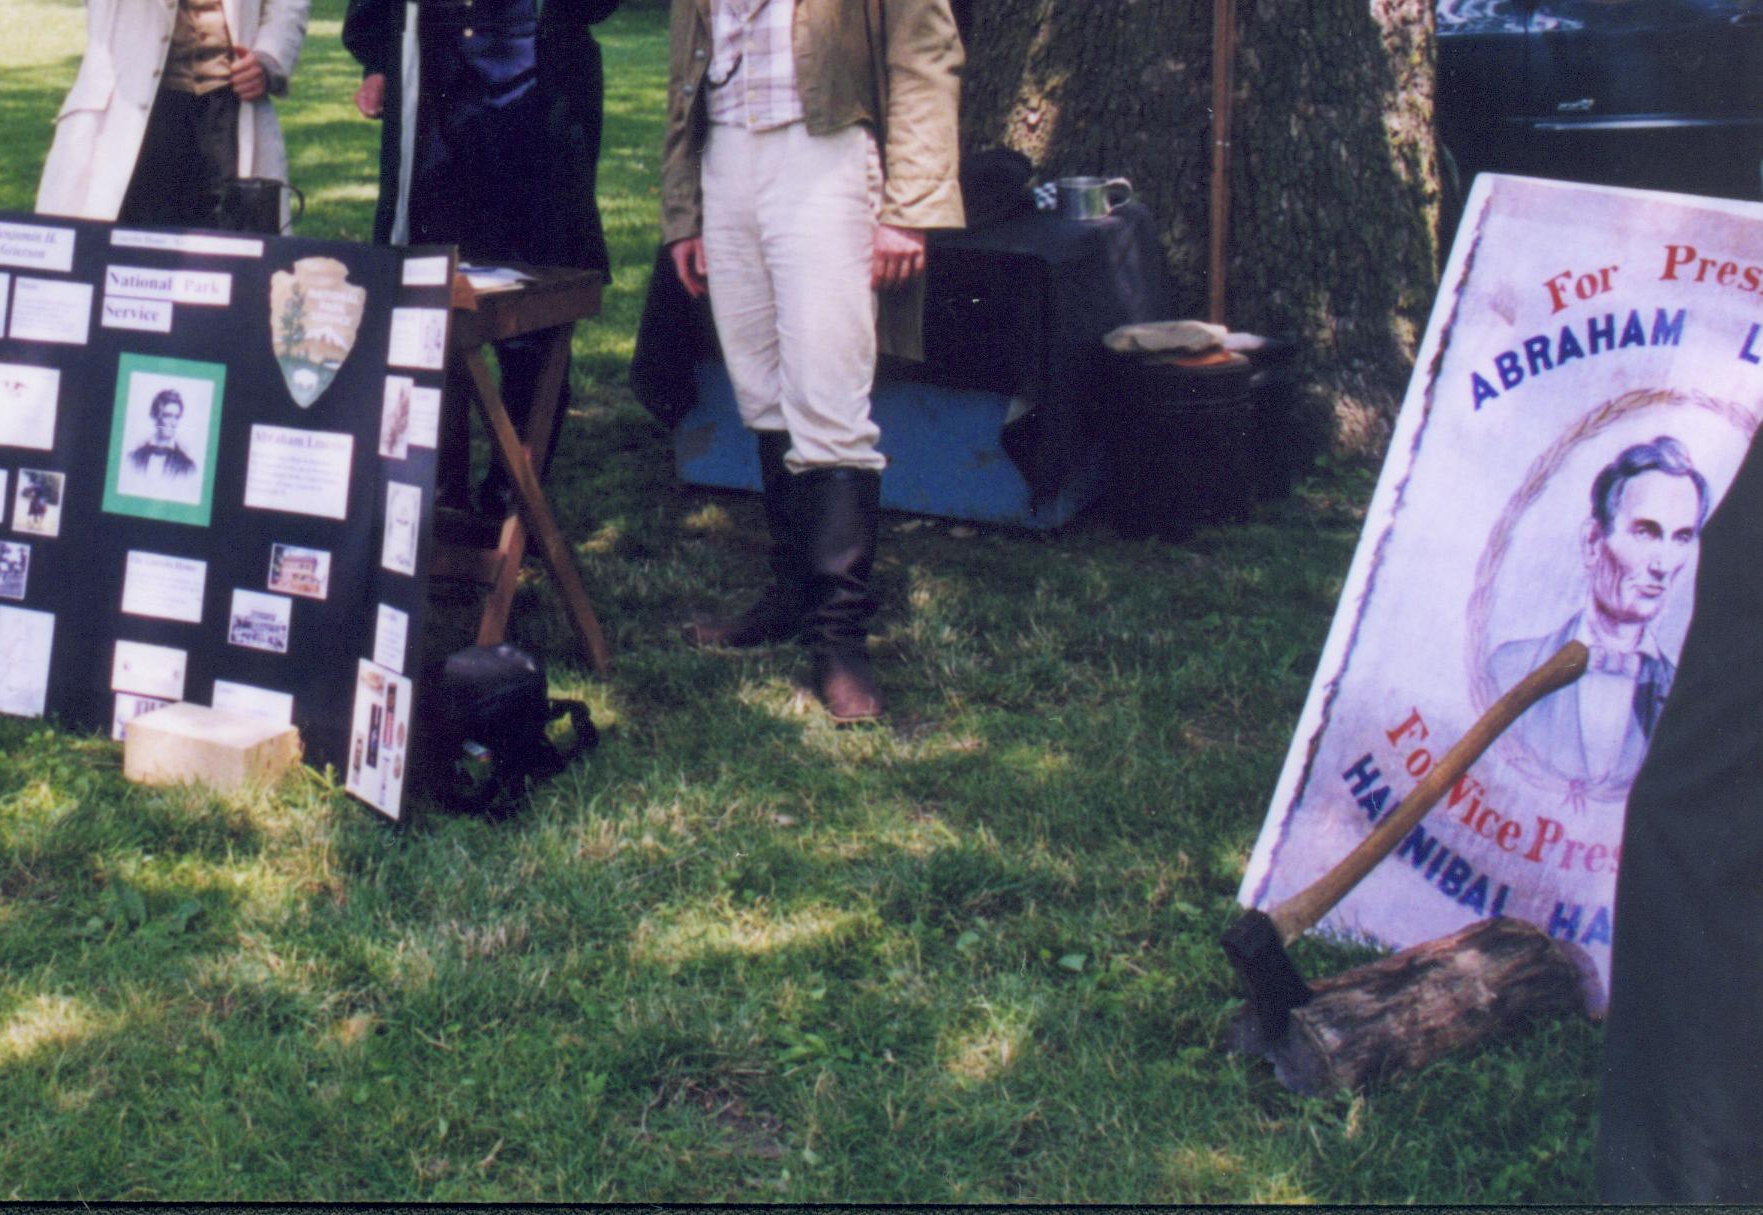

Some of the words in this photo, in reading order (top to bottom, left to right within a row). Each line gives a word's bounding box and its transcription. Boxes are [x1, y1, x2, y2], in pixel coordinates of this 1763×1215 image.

[105, 304, 160, 322] Service
[109, 271, 173, 291] National
[184, 278, 220, 294] Park
[1542, 264, 1620, 315] For
[1658, 244, 1763, 296] Pres
[1470, 307, 1686, 412] ABRAHAM
[1386, 706, 1439, 786] Fo
[1445, 773, 1523, 853] Vice
